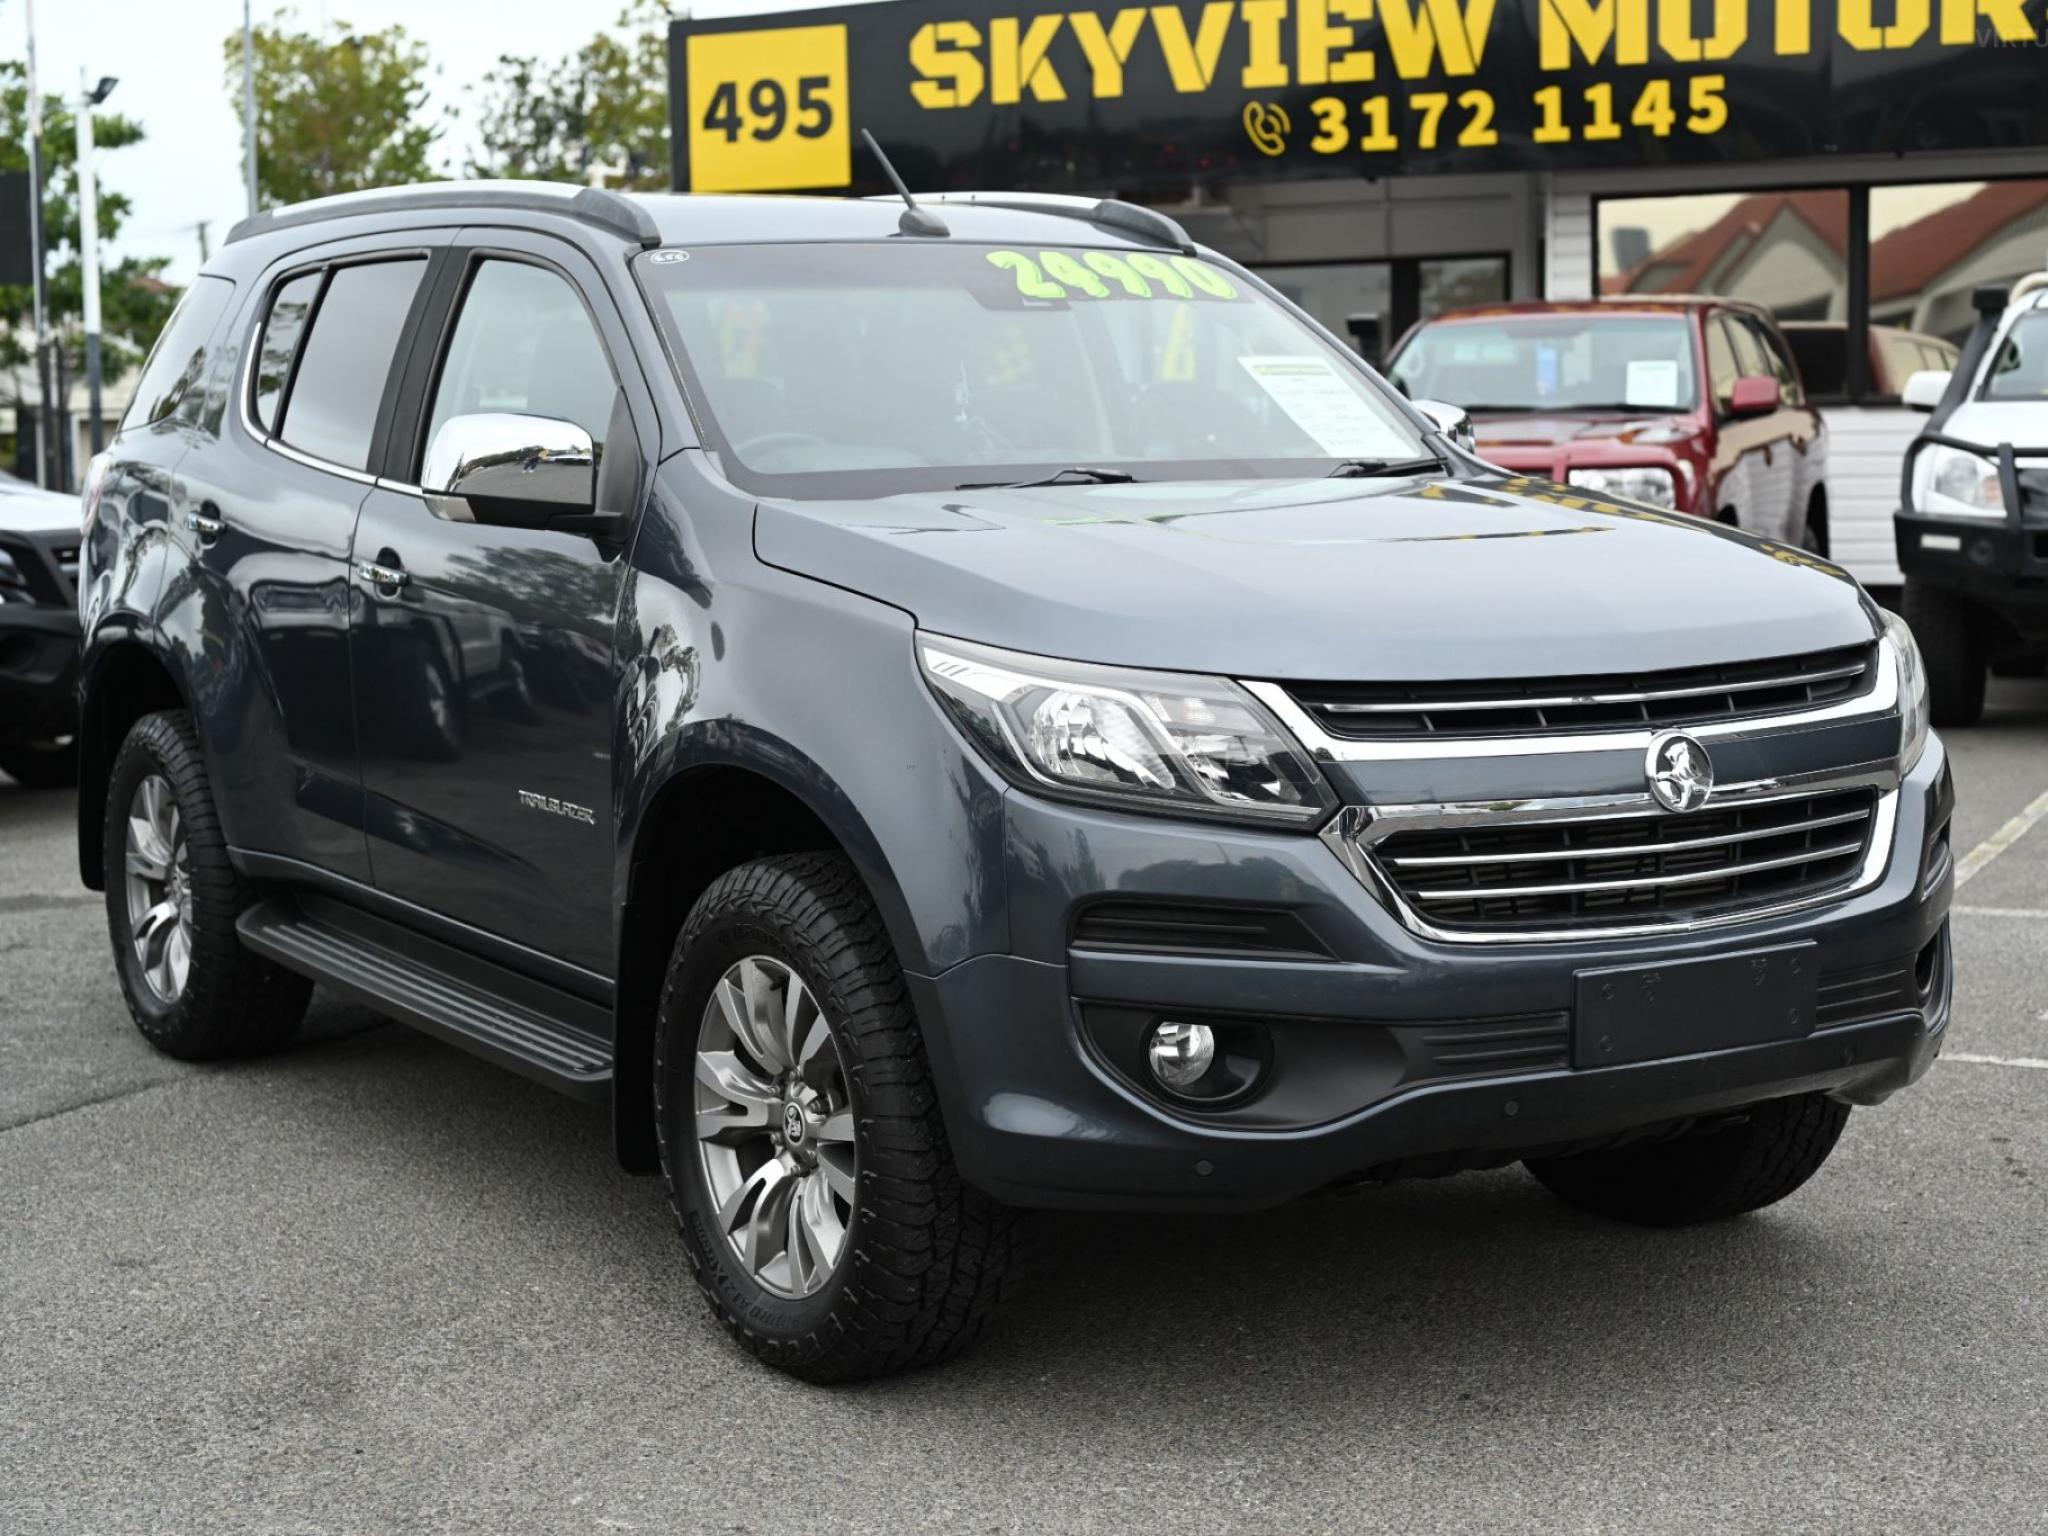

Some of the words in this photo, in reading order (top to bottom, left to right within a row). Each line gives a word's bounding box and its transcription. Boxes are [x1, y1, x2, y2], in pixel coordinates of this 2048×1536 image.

[909, 0, 1496, 109] SKYVIEW
[703, 76, 832, 142] 495
[1311, 90, 1497, 153] 3172
[1534, 76, 1728, 142] 1145
[985, 250, 1238, 298] 24990
